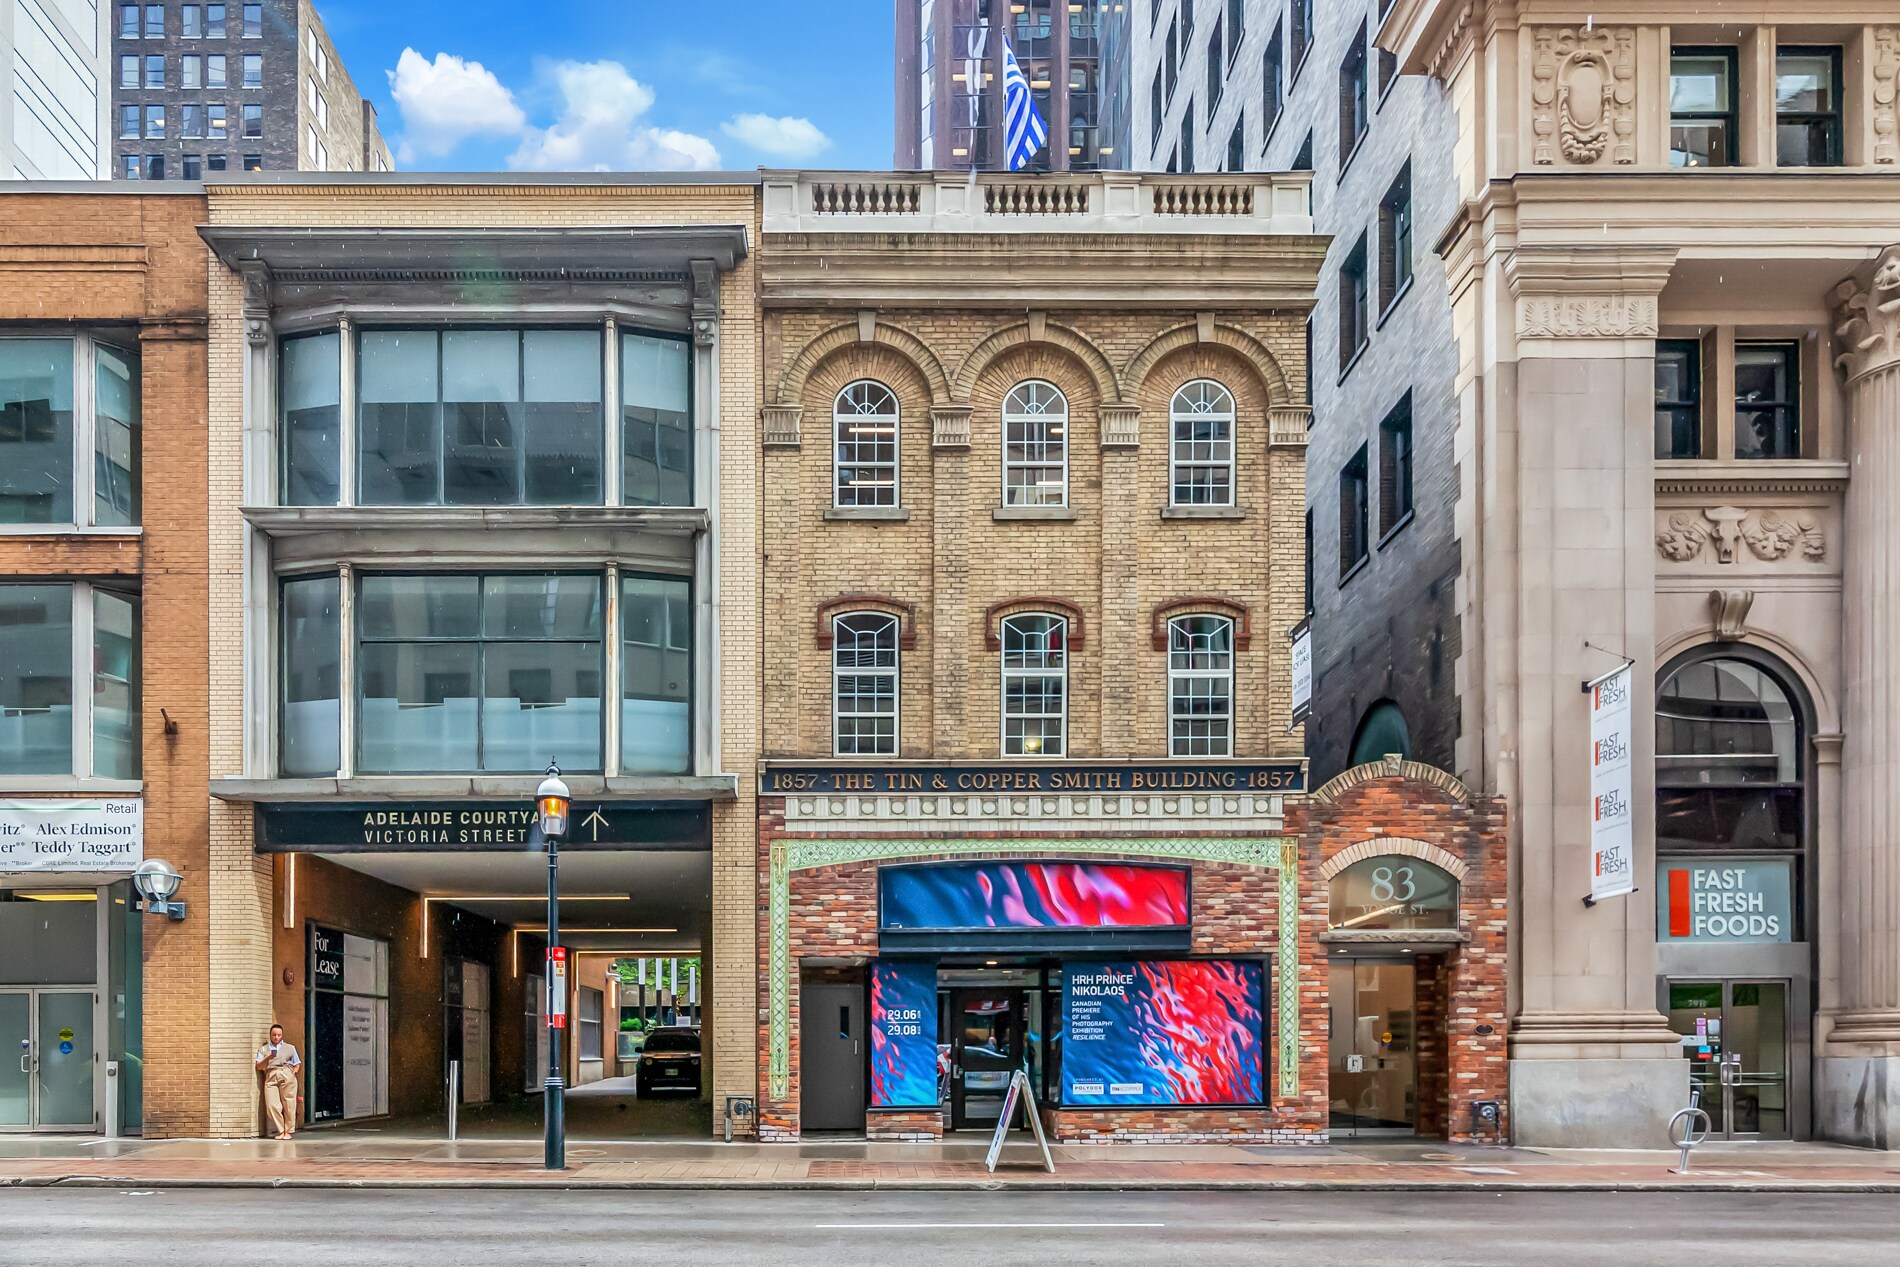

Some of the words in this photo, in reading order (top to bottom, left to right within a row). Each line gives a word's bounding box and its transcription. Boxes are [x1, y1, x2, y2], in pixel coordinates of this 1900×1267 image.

[1599, 675, 1620, 695] FAST
[1599, 685, 1626, 709] FRESH
[1599, 732, 1619, 752] FAST
[1599, 742, 1626, 765] FRESH
[885, 773, 923, 790] TIN
[931, 773, 949, 790] &
[957, 772, 1041, 790] COPPER
[1049, 772, 1122, 789] SMITH
[1599, 789, 1619, 808] FAST
[106, 803, 137, 814] Retail
[1599, 800, 1627, 820] FRESH
[364, 811, 453, 825] ADELAIDE
[460, 811, 539, 825] COURTYA
[36, 823, 67, 835] Alex
[364, 830, 449, 843] VICTORIA
[460, 829, 527, 843] STREET
[32, 841, 75, 856] Teddy
[1600, 846, 1621, 864] FAST
[110, 860, 137, 868] Brokerage
[1600, 857, 1628, 876] FRESH
[1370, 866, 1416, 902] 83
[1694, 869, 1746, 889] FAST
[1361, 904, 1406, 915] YOGE
[1410, 904, 1429, 915] ST.
[1694, 892, 1764, 913] FRESH
[1695, 915, 1780, 936] FOODS
[315, 931, 329, 952] For
[315, 953, 340, 975] Lease
[1072, 975, 1094, 985] HRH
[1096, 975, 1134, 985] PRINCE
[1072, 986, 1125, 996] NIKOLAOS
[887, 1009, 917, 1020] 29.06
[887, 1025, 917, 1036] 29.08
